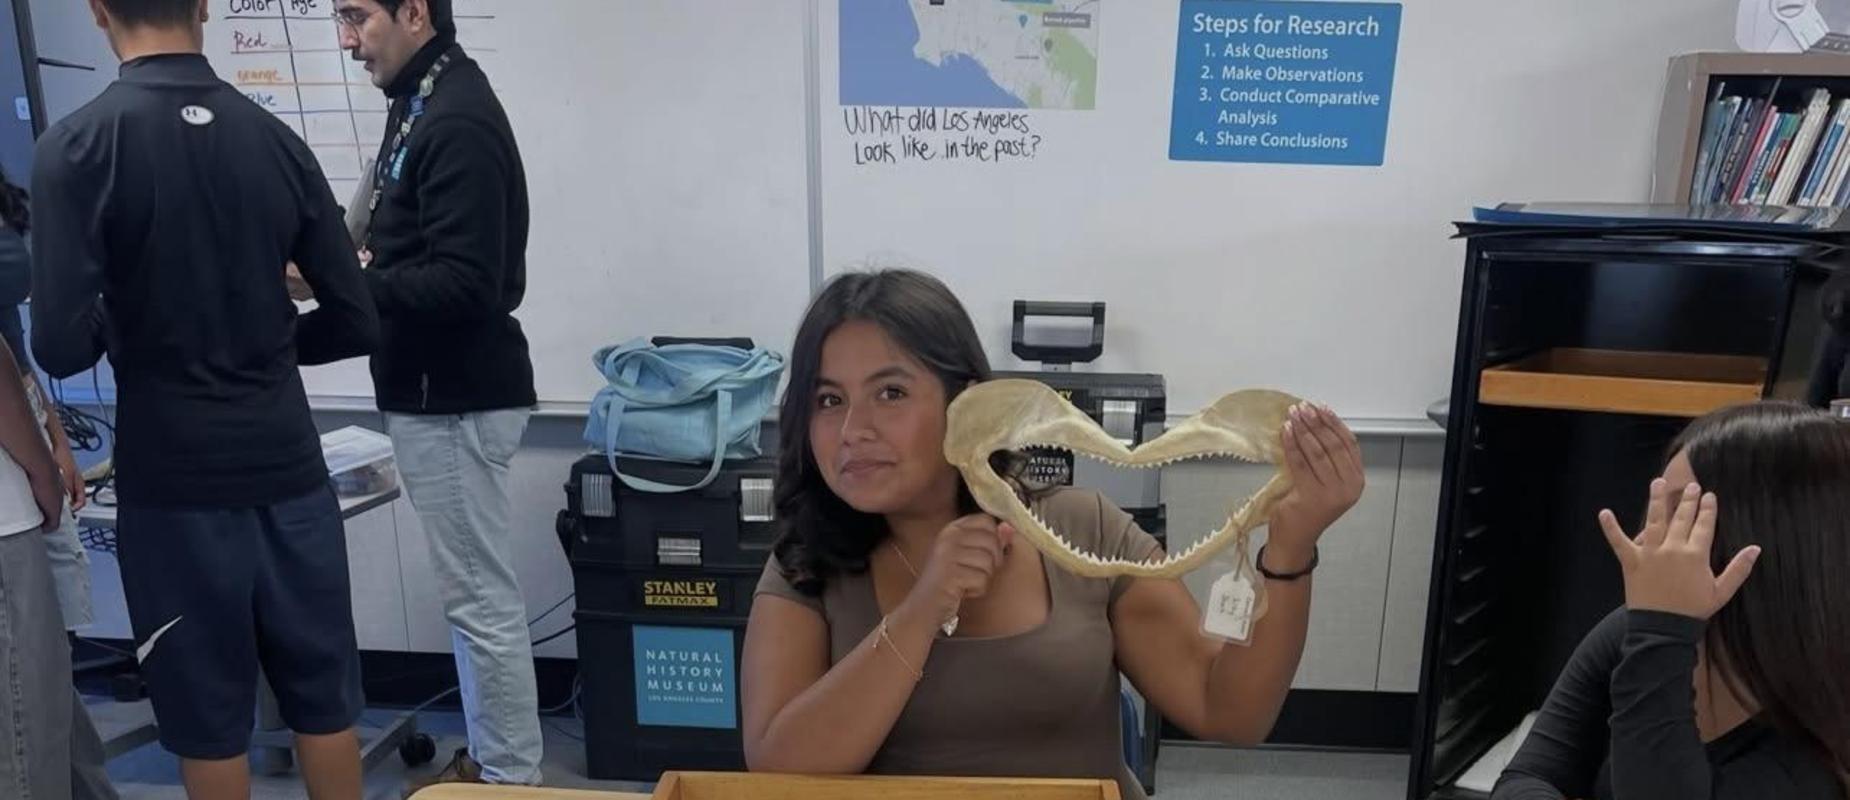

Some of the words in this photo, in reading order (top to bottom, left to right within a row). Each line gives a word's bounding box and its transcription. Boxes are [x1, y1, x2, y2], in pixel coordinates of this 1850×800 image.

[1193, 13, 1248, 38] Steps
[1254, 13, 1283, 34] for
[1288, 15, 1380, 36] Research
[234, 30, 268, 53] Red
[1204, 44, 1216, 58] 1.
[1224, 44, 1250, 58] Ask
[1254, 44, 1329, 60] Questions
[1201, 66, 1214, 80] 2.
[1222, 66, 1262, 81] Make
[1265, 66, 1364, 82] Observations
[1199, 88, 1212, 102] 3.
[1220, 88, 1282, 104] Conduct
[1285, 89, 1380, 107] Comparative
[844, 106, 905, 136] What
[908, 108, 936, 132] did
[942, 108, 969, 132] Los
[972, 110, 1030, 134] Angeles
[1218, 110, 1278, 127] Analysis
[961, 136, 991, 161] the
[994, 135, 1041, 162] past?
[1195, 131, 1208, 145] 4.
[1216, 131, 1257, 146] Share
[1260, 132, 1348, 149] Conclusions
[644, 581, 716, 595] STANLEY
[646, 650, 723, 663] NATURAL
[646, 664, 723, 677] HISTORY
[647, 680, 723, 692] MUSEUM
